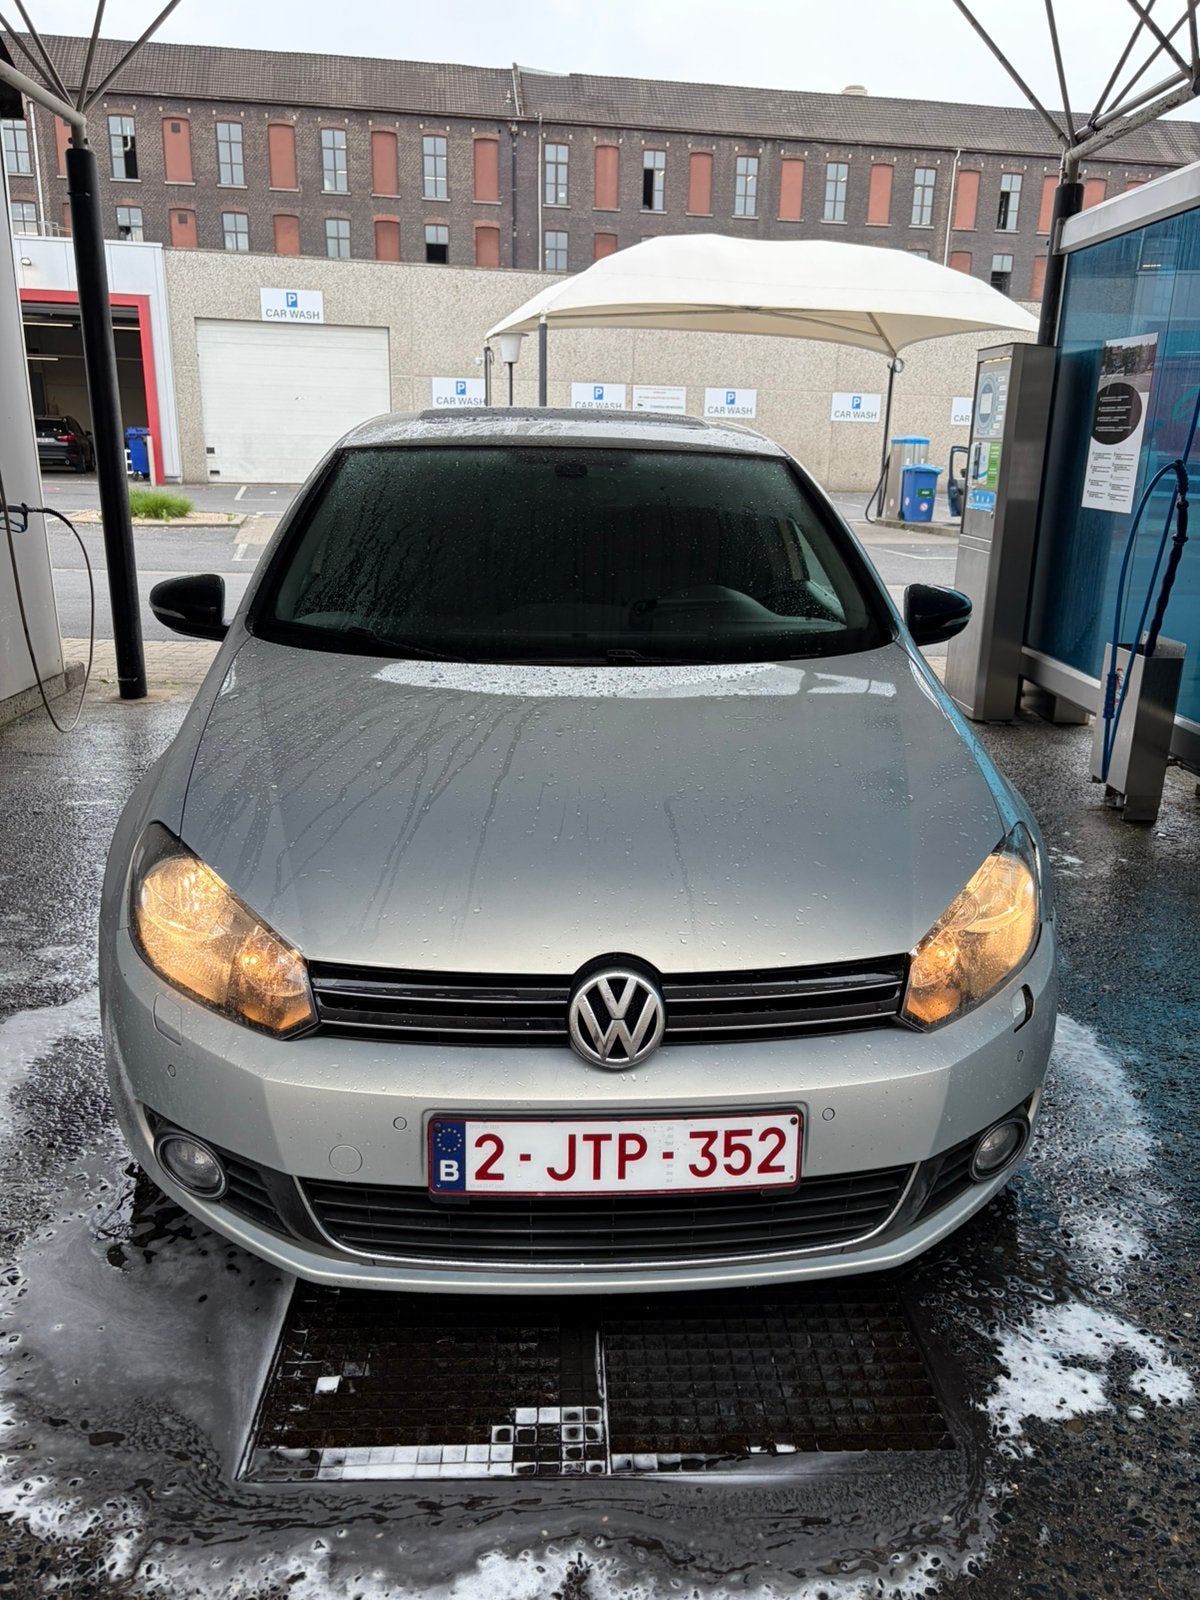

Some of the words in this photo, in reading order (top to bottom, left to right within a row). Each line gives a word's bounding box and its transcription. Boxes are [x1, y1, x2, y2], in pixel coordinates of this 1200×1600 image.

[287, 293, 297, 306] P
[265, 308, 287, 318] CAR
[289, 309, 320, 320] WASH
[457, 382, 465, 394] P
[595, 388, 603, 399] P
[436, 396, 456, 405] CAR
[727, 393, 735, 404] P
[853, 397, 861, 408] P
[575, 401, 595, 409] CAR
[707, 406, 726, 415] CAR
[727, 406, 753, 415] WASH
[834, 410, 851, 419] CAR
[852, 411, 878, 420] WASH
[953, 414, 970, 423] CAR
[573, 974, 661, 1064] VW
[440, 1159, 460, 1182] B
